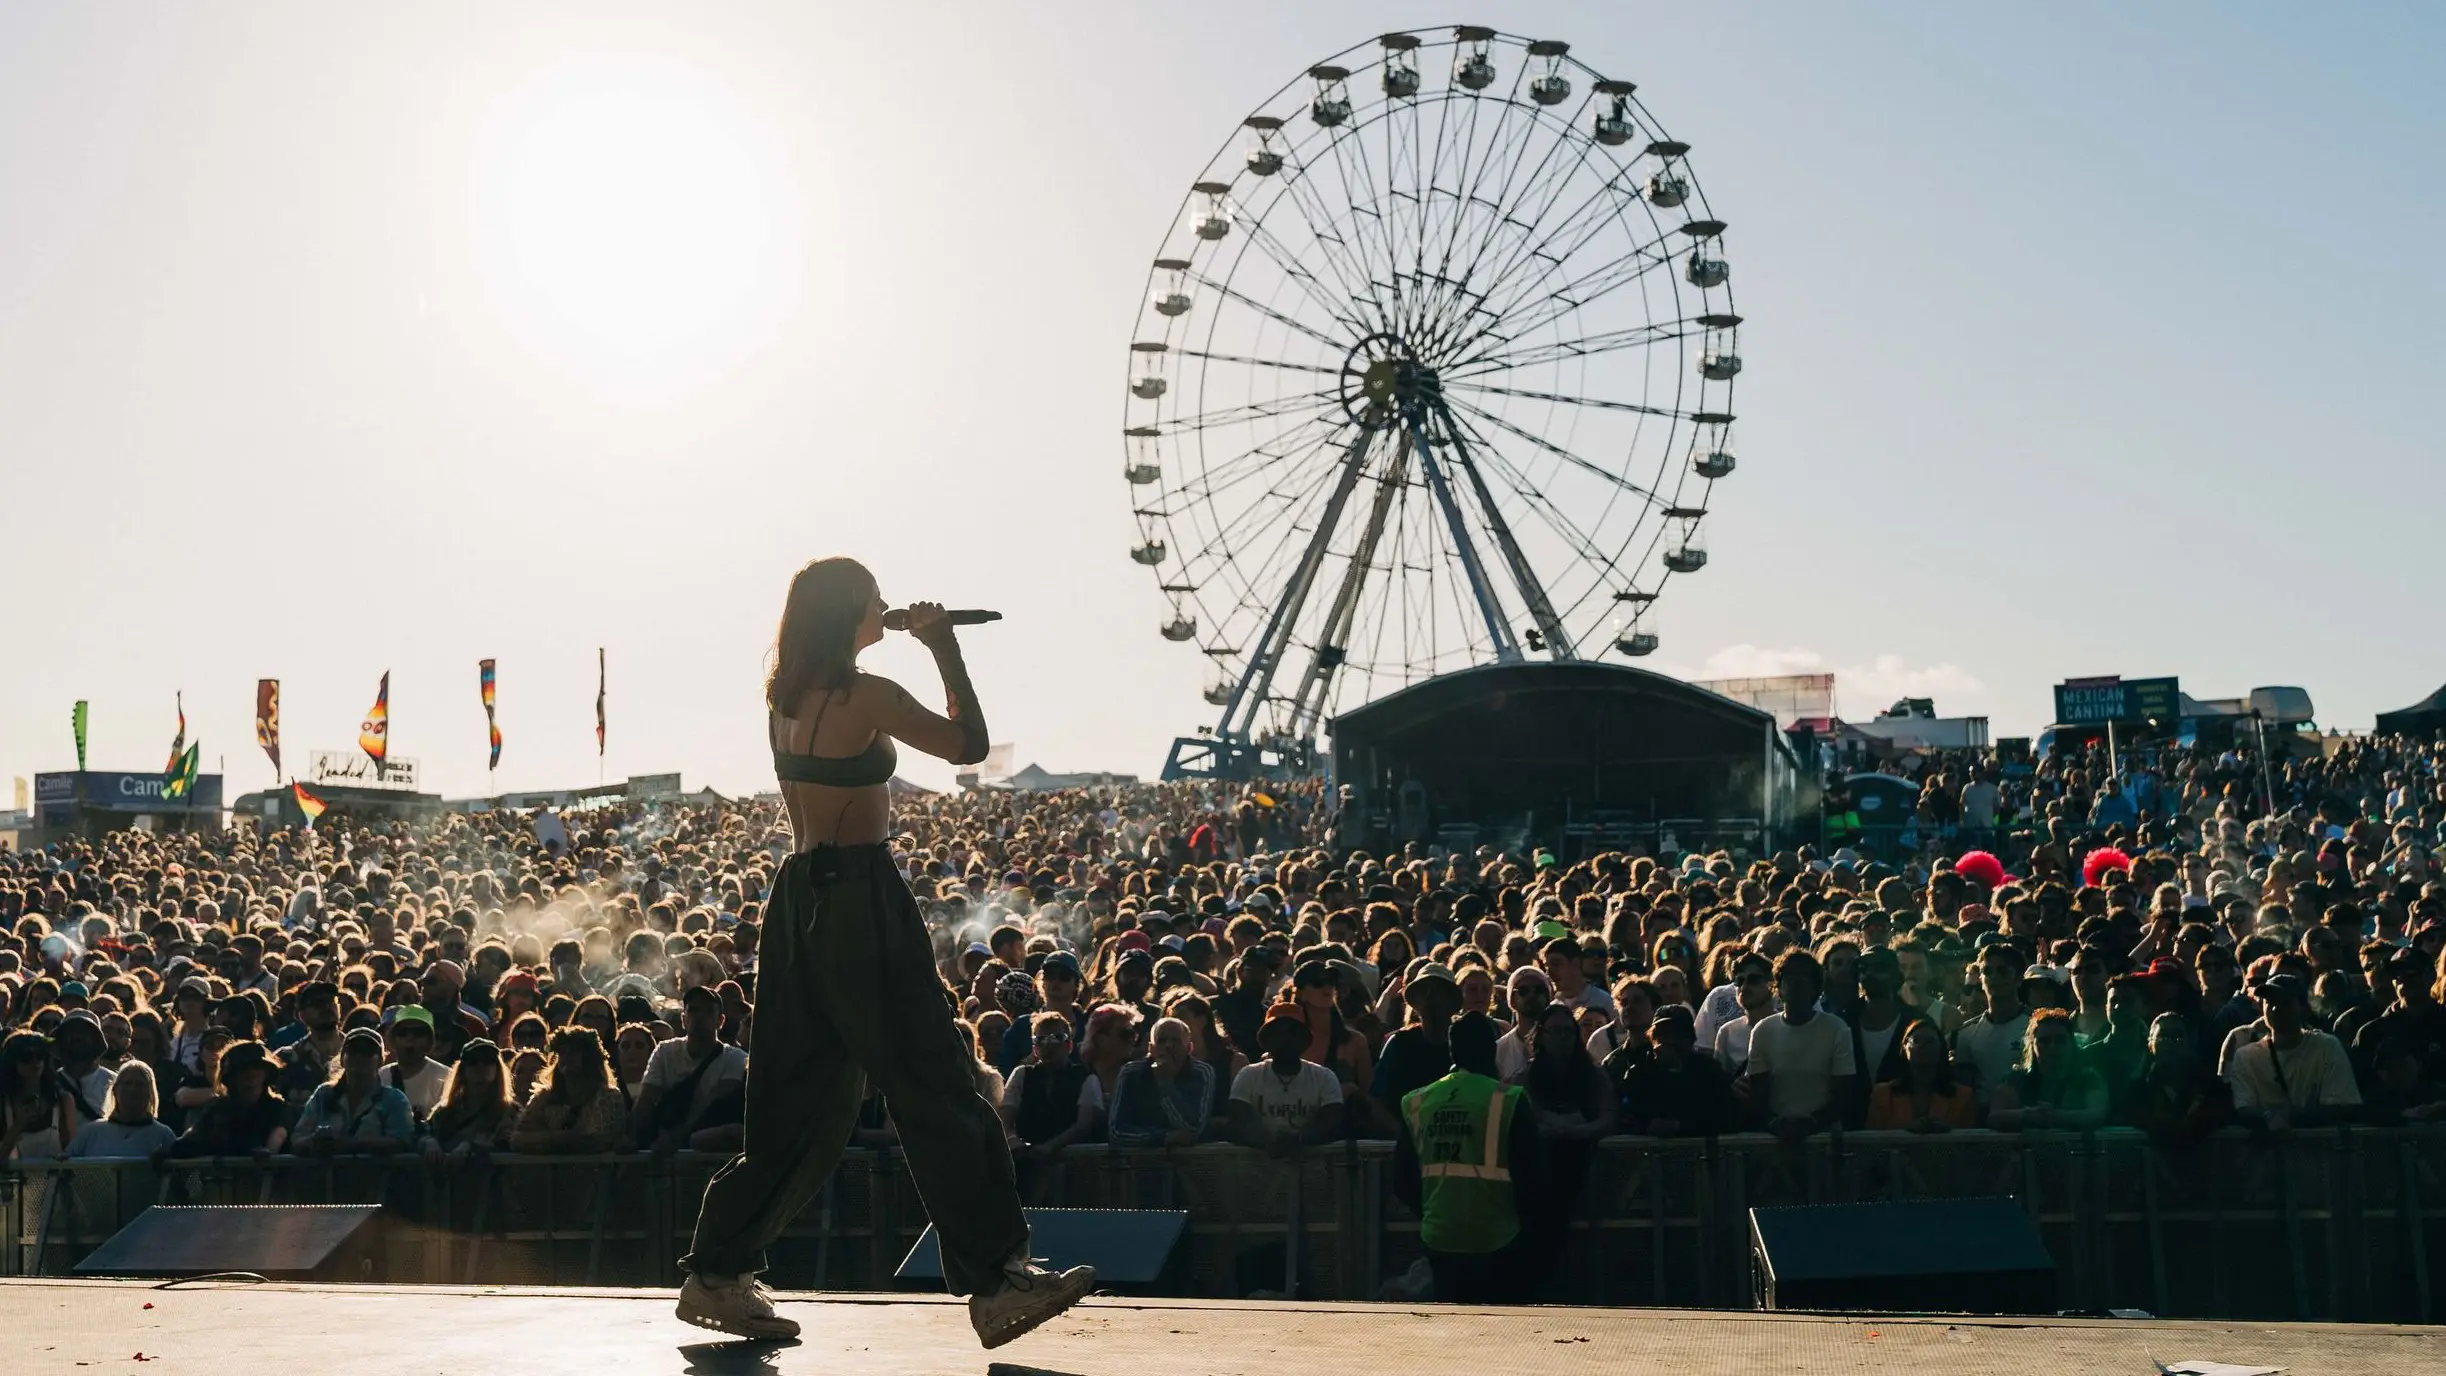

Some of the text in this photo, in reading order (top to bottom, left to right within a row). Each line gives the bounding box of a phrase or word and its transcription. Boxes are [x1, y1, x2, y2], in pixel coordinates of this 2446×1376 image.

[2063, 687, 2125, 705] MEXICAN
[2065, 703, 2125, 719] CANTINA
[119, 776, 172, 796] Cam
